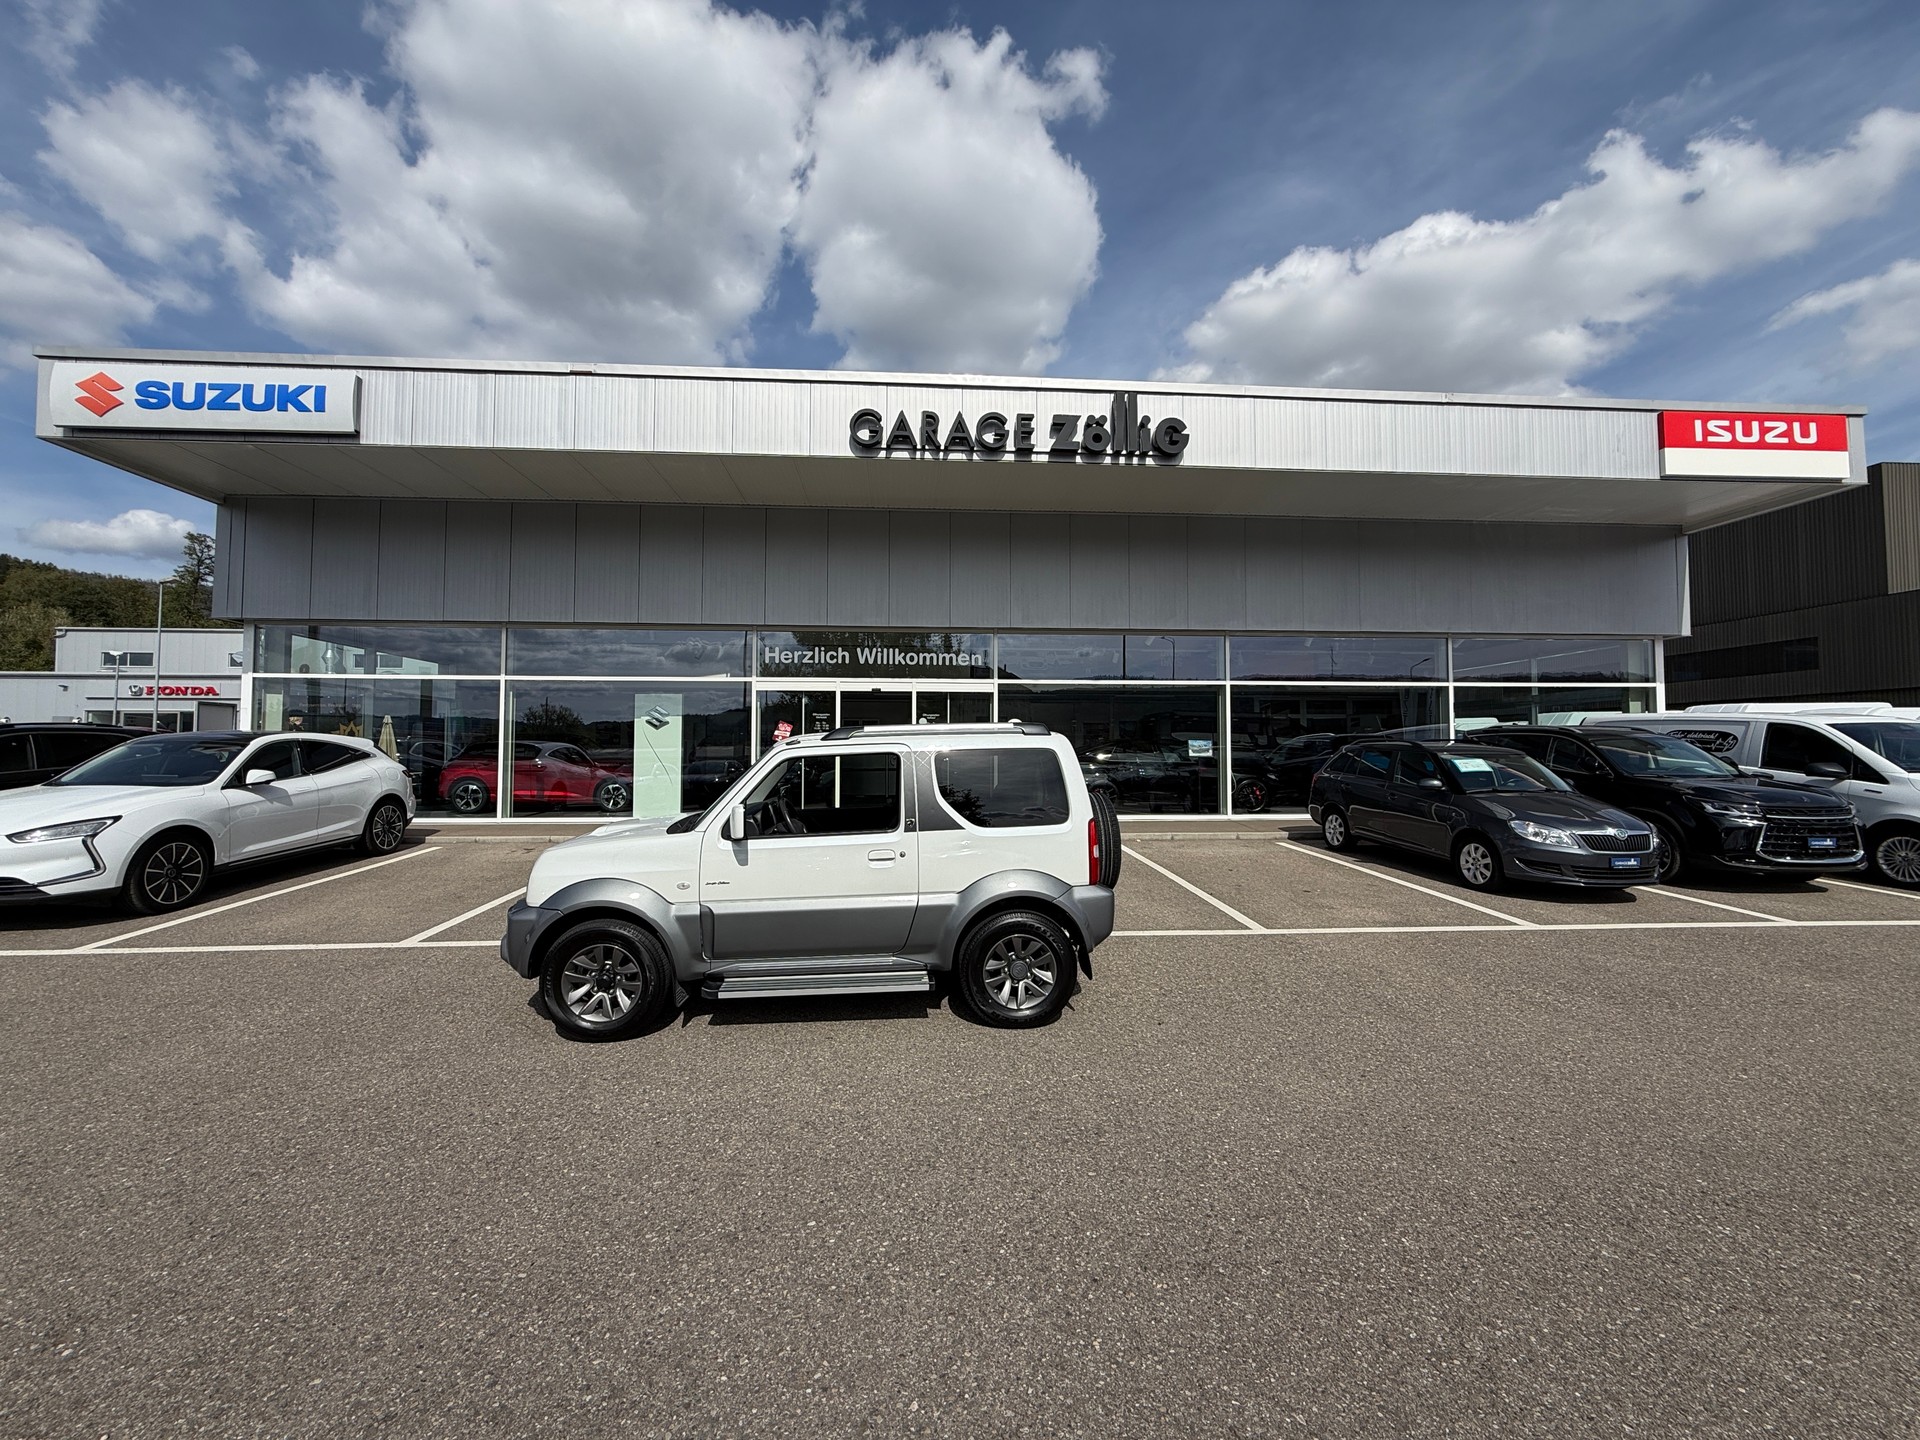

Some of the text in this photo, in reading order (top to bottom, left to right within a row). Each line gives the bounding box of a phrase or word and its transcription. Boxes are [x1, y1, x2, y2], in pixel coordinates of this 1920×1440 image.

[134, 380, 326, 413] SUZUKI
[850, 408, 1035, 451] GARAGE
[1694, 419, 1818, 444] ISUZU
[764, 646, 982, 666] Herzlich Willkommen
[145, 686, 219, 696] HONDA
